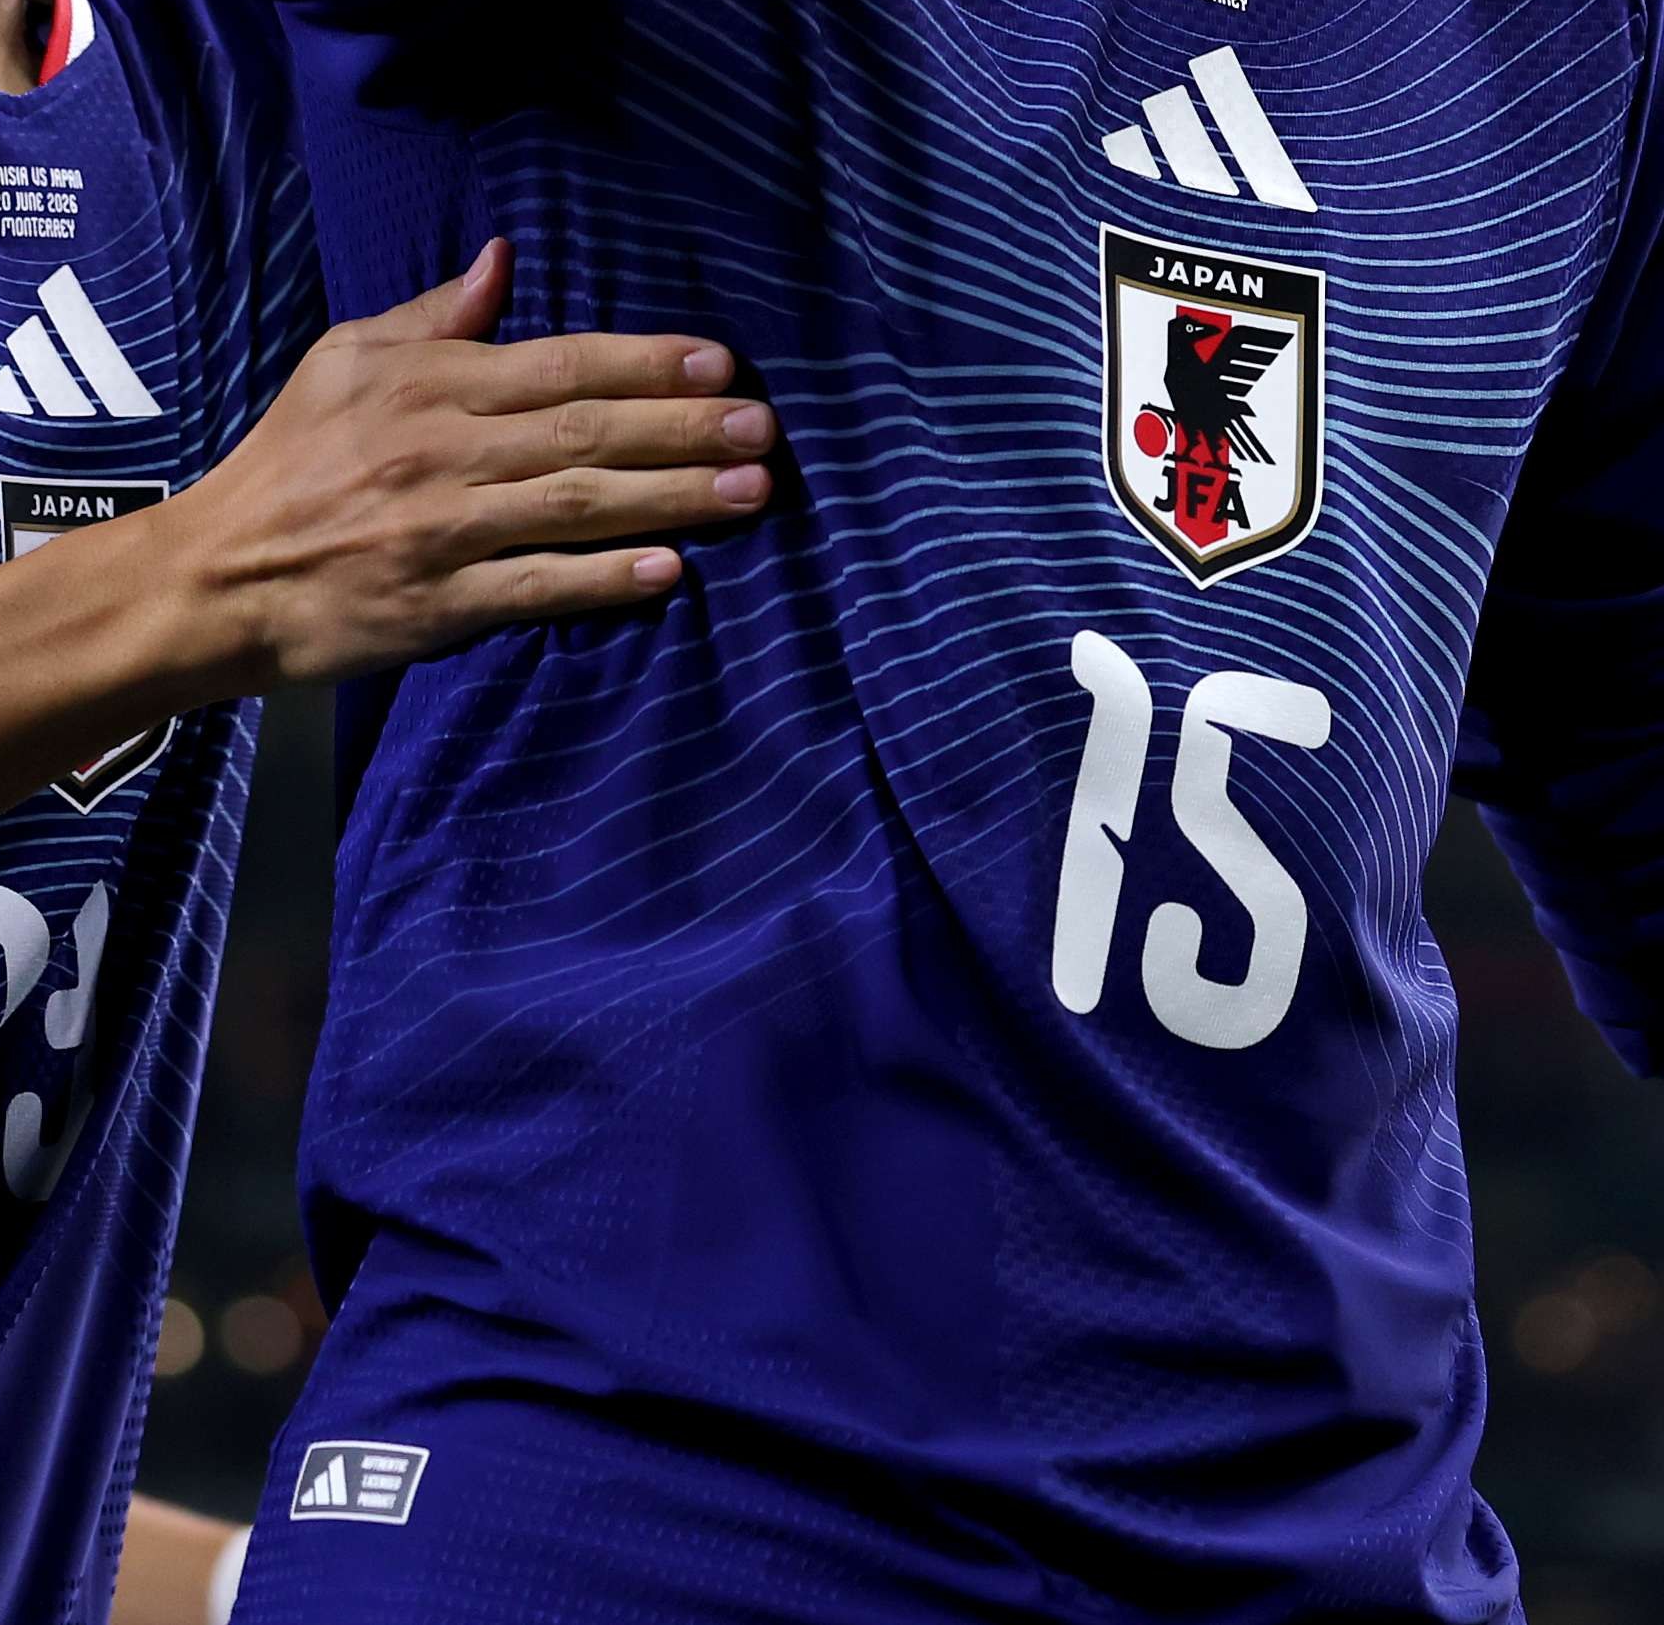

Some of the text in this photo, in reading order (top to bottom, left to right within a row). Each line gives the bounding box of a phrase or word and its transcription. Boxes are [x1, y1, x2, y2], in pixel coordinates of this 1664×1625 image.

[50, 168, 84, 190] JAPAN
[15, 192, 45, 212] JUNE
[47, 193, 78, 214] 2026
[1, 217, 75, 239] MONTERREY
[1149, 256, 1264, 299] JAPAN
[30, 494, 115, 519] JAPAN
[1153, 465, 1251, 530] JFA
[1052, 629, 1331, 1049] 15
